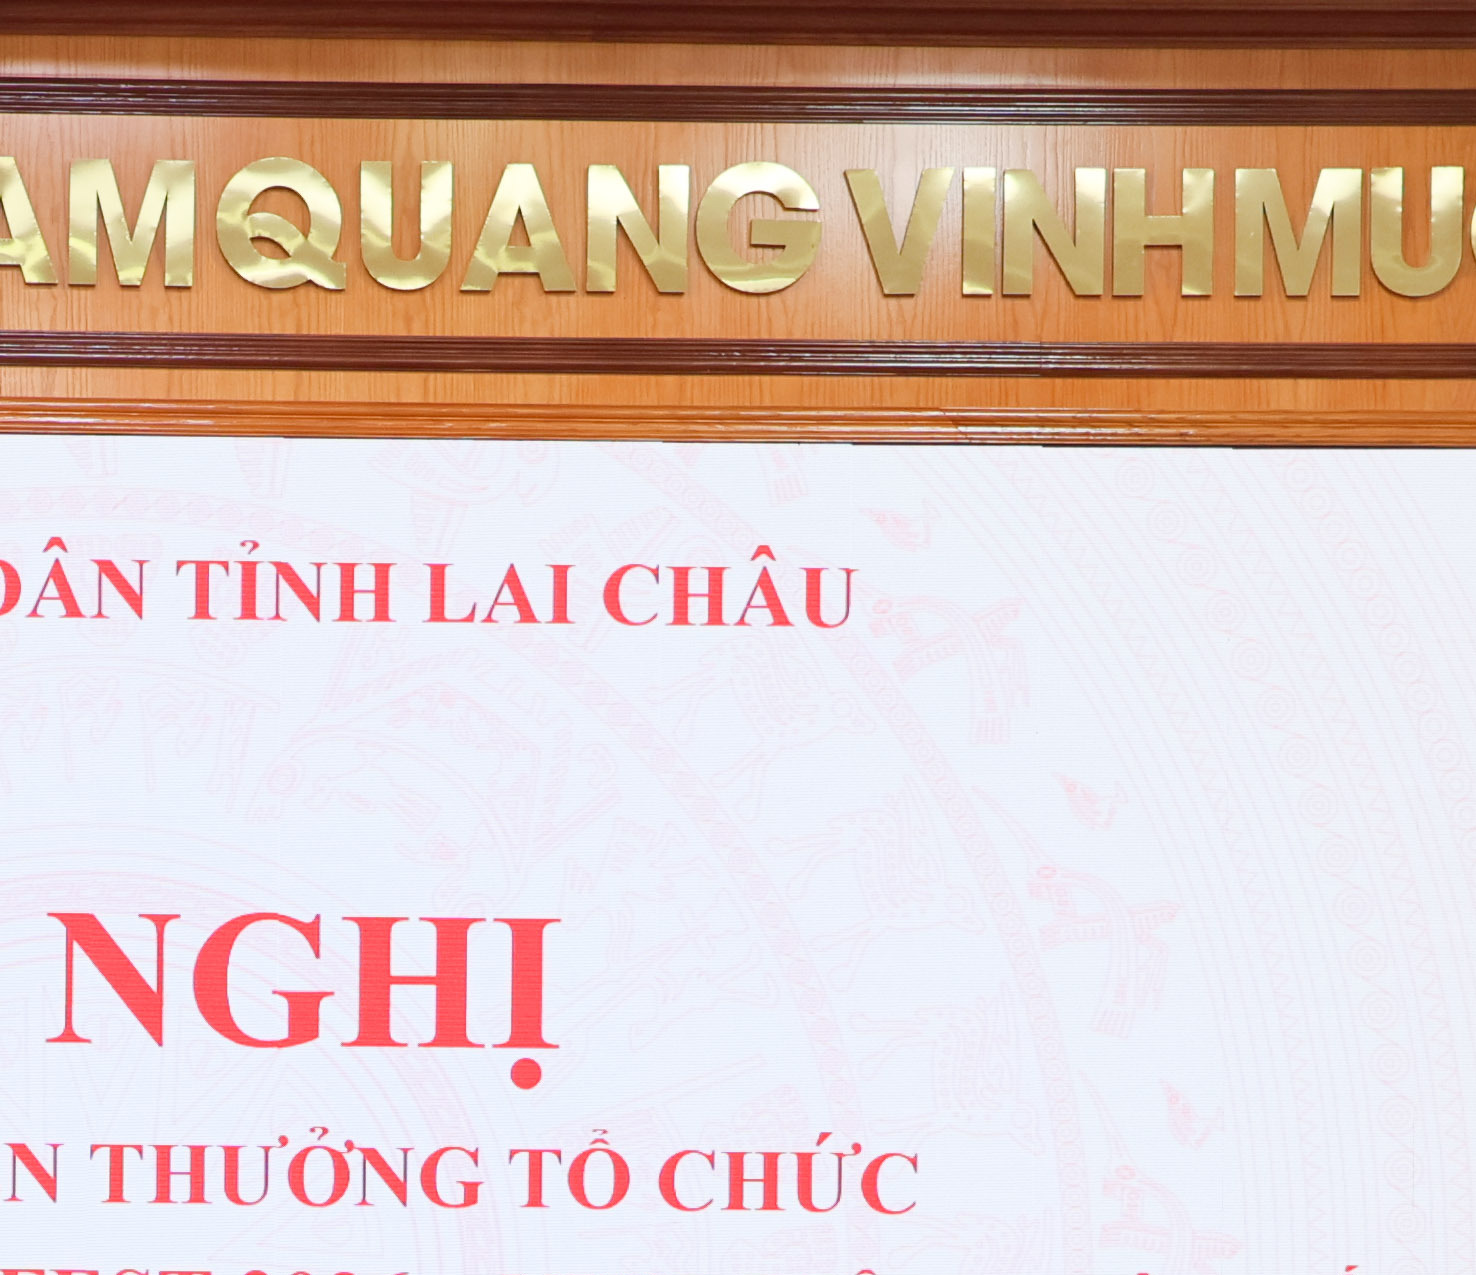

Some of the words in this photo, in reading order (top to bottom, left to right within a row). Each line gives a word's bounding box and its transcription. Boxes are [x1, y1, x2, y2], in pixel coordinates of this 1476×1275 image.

[214, 157, 823, 294] QUANG
[845, 163, 1215, 300] VINH
[176, 539, 394, 624] TỈNH
[427, 562, 573, 626] LAI
[602, 543, 855, 630] CHÂU
[46, 911, 562, 1091] NGHỊ
[90, 1124, 482, 1210] THƯỞNG
[509, 1122, 631, 1212] TỔ
[657, 1131, 919, 1216] CHỨC
